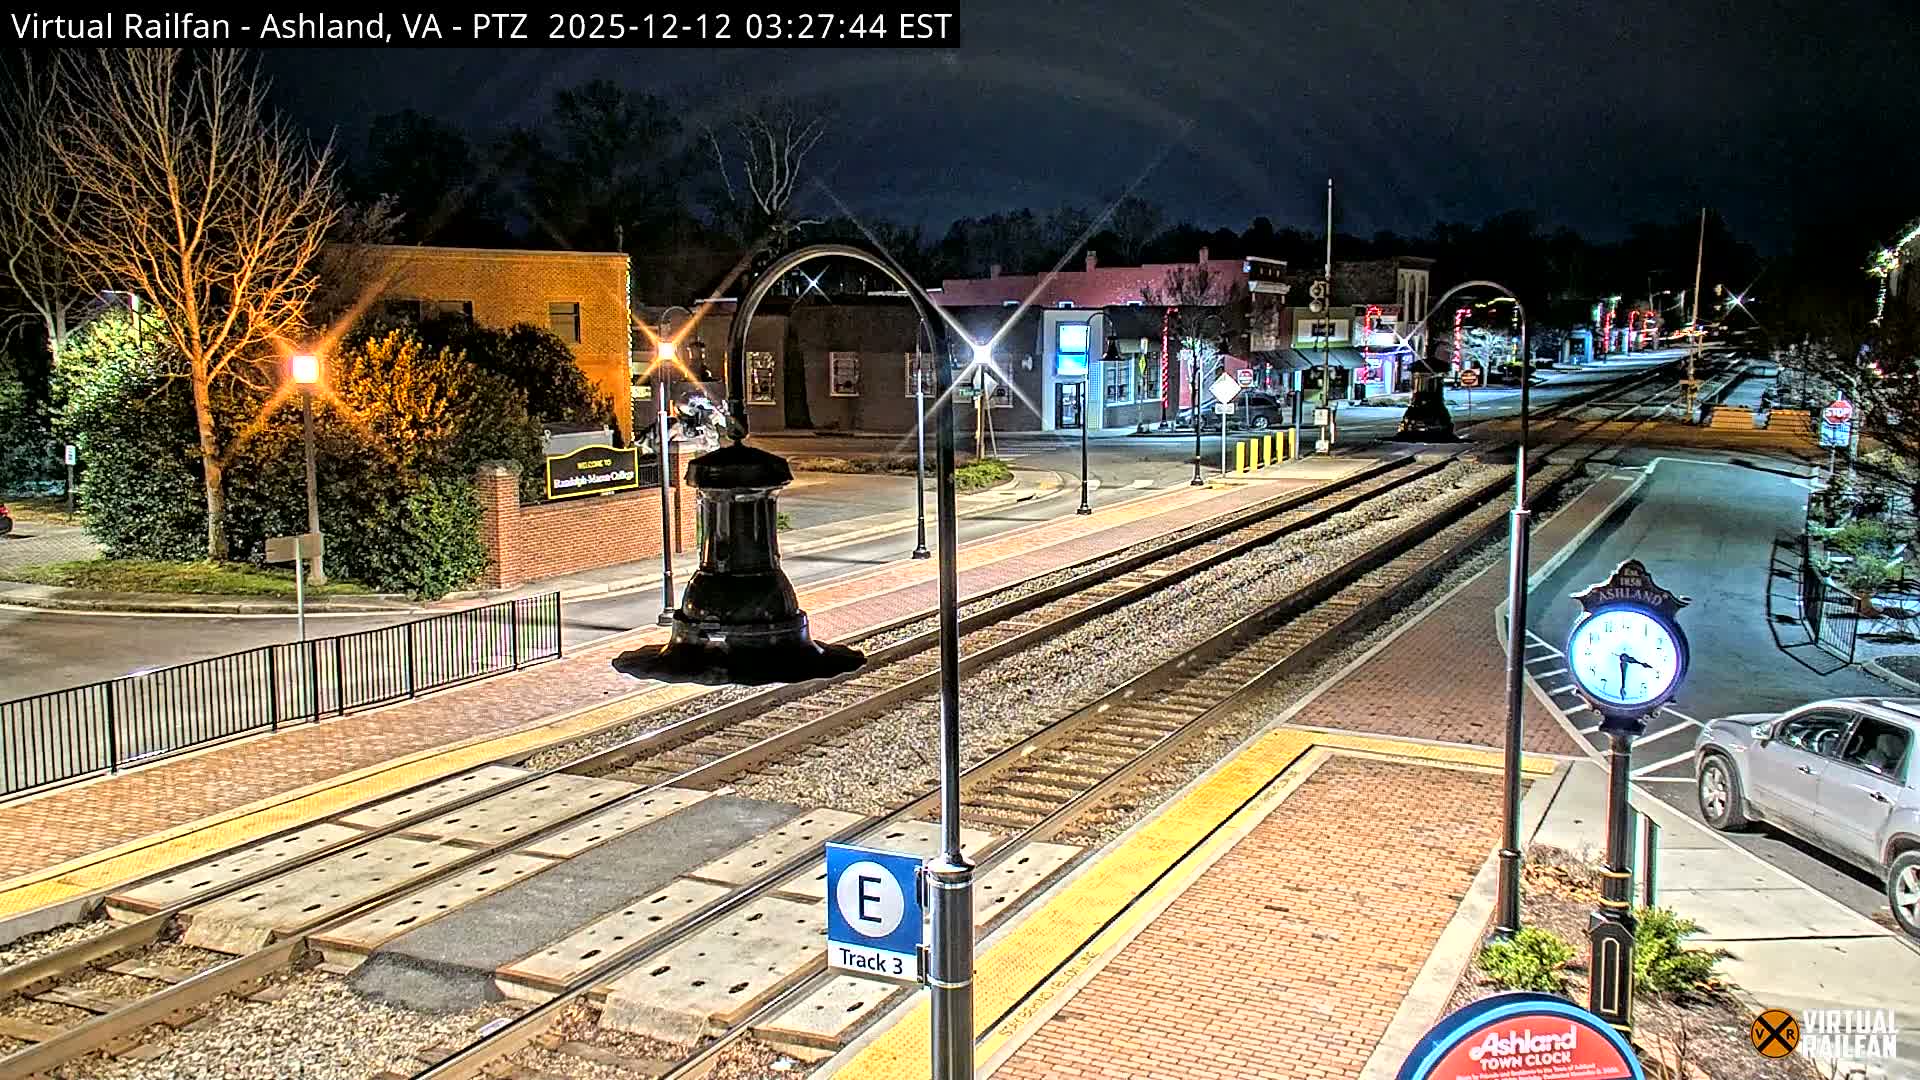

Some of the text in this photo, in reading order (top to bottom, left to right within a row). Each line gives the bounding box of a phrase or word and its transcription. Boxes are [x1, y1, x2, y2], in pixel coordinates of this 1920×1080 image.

[1825, 407, 1852, 419] STOP
[1599, 587, 1663, 606] ASHLAND
[858, 874, 882, 923] E
[839, 947, 903, 975] Track 3
[1469, 1024, 1577, 1061] Ashland
[1480, 1051, 1572, 1071] TOWN CLOCK
